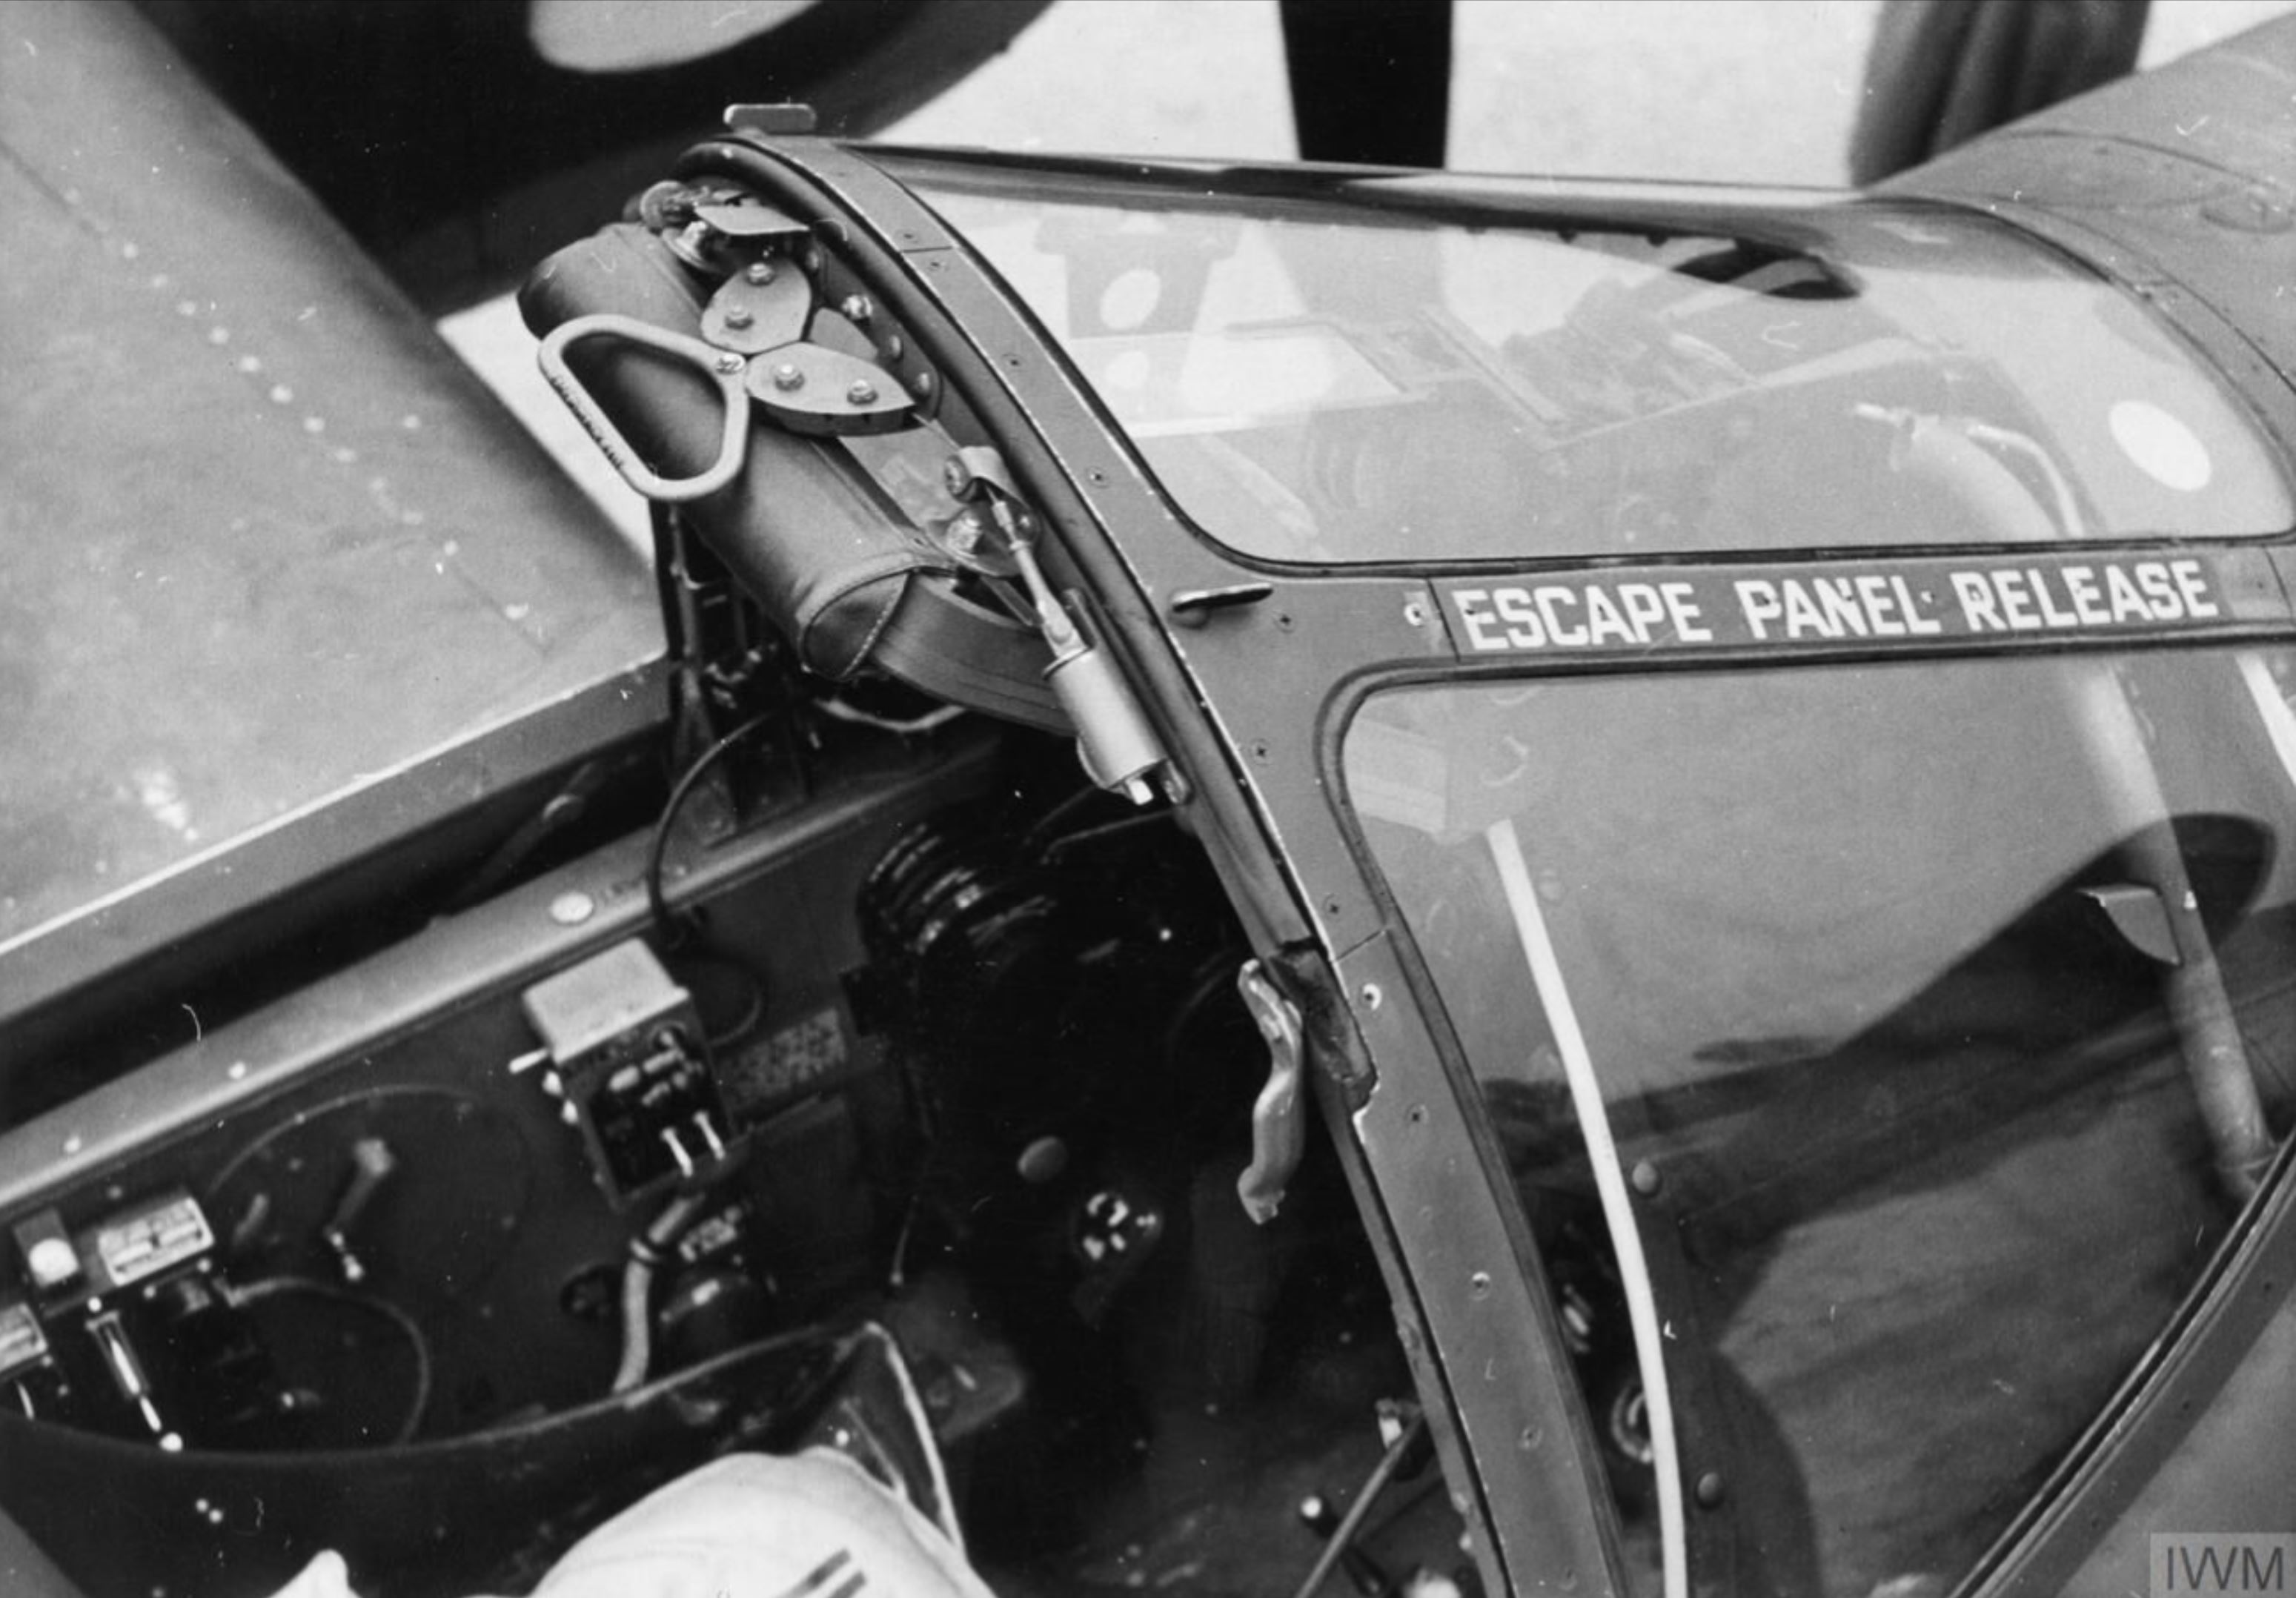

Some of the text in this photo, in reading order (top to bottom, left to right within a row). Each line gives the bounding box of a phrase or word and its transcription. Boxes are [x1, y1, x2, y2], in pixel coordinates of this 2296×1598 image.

[1450, 560, 2218, 651] ESCAPE PANEL RELEASE
